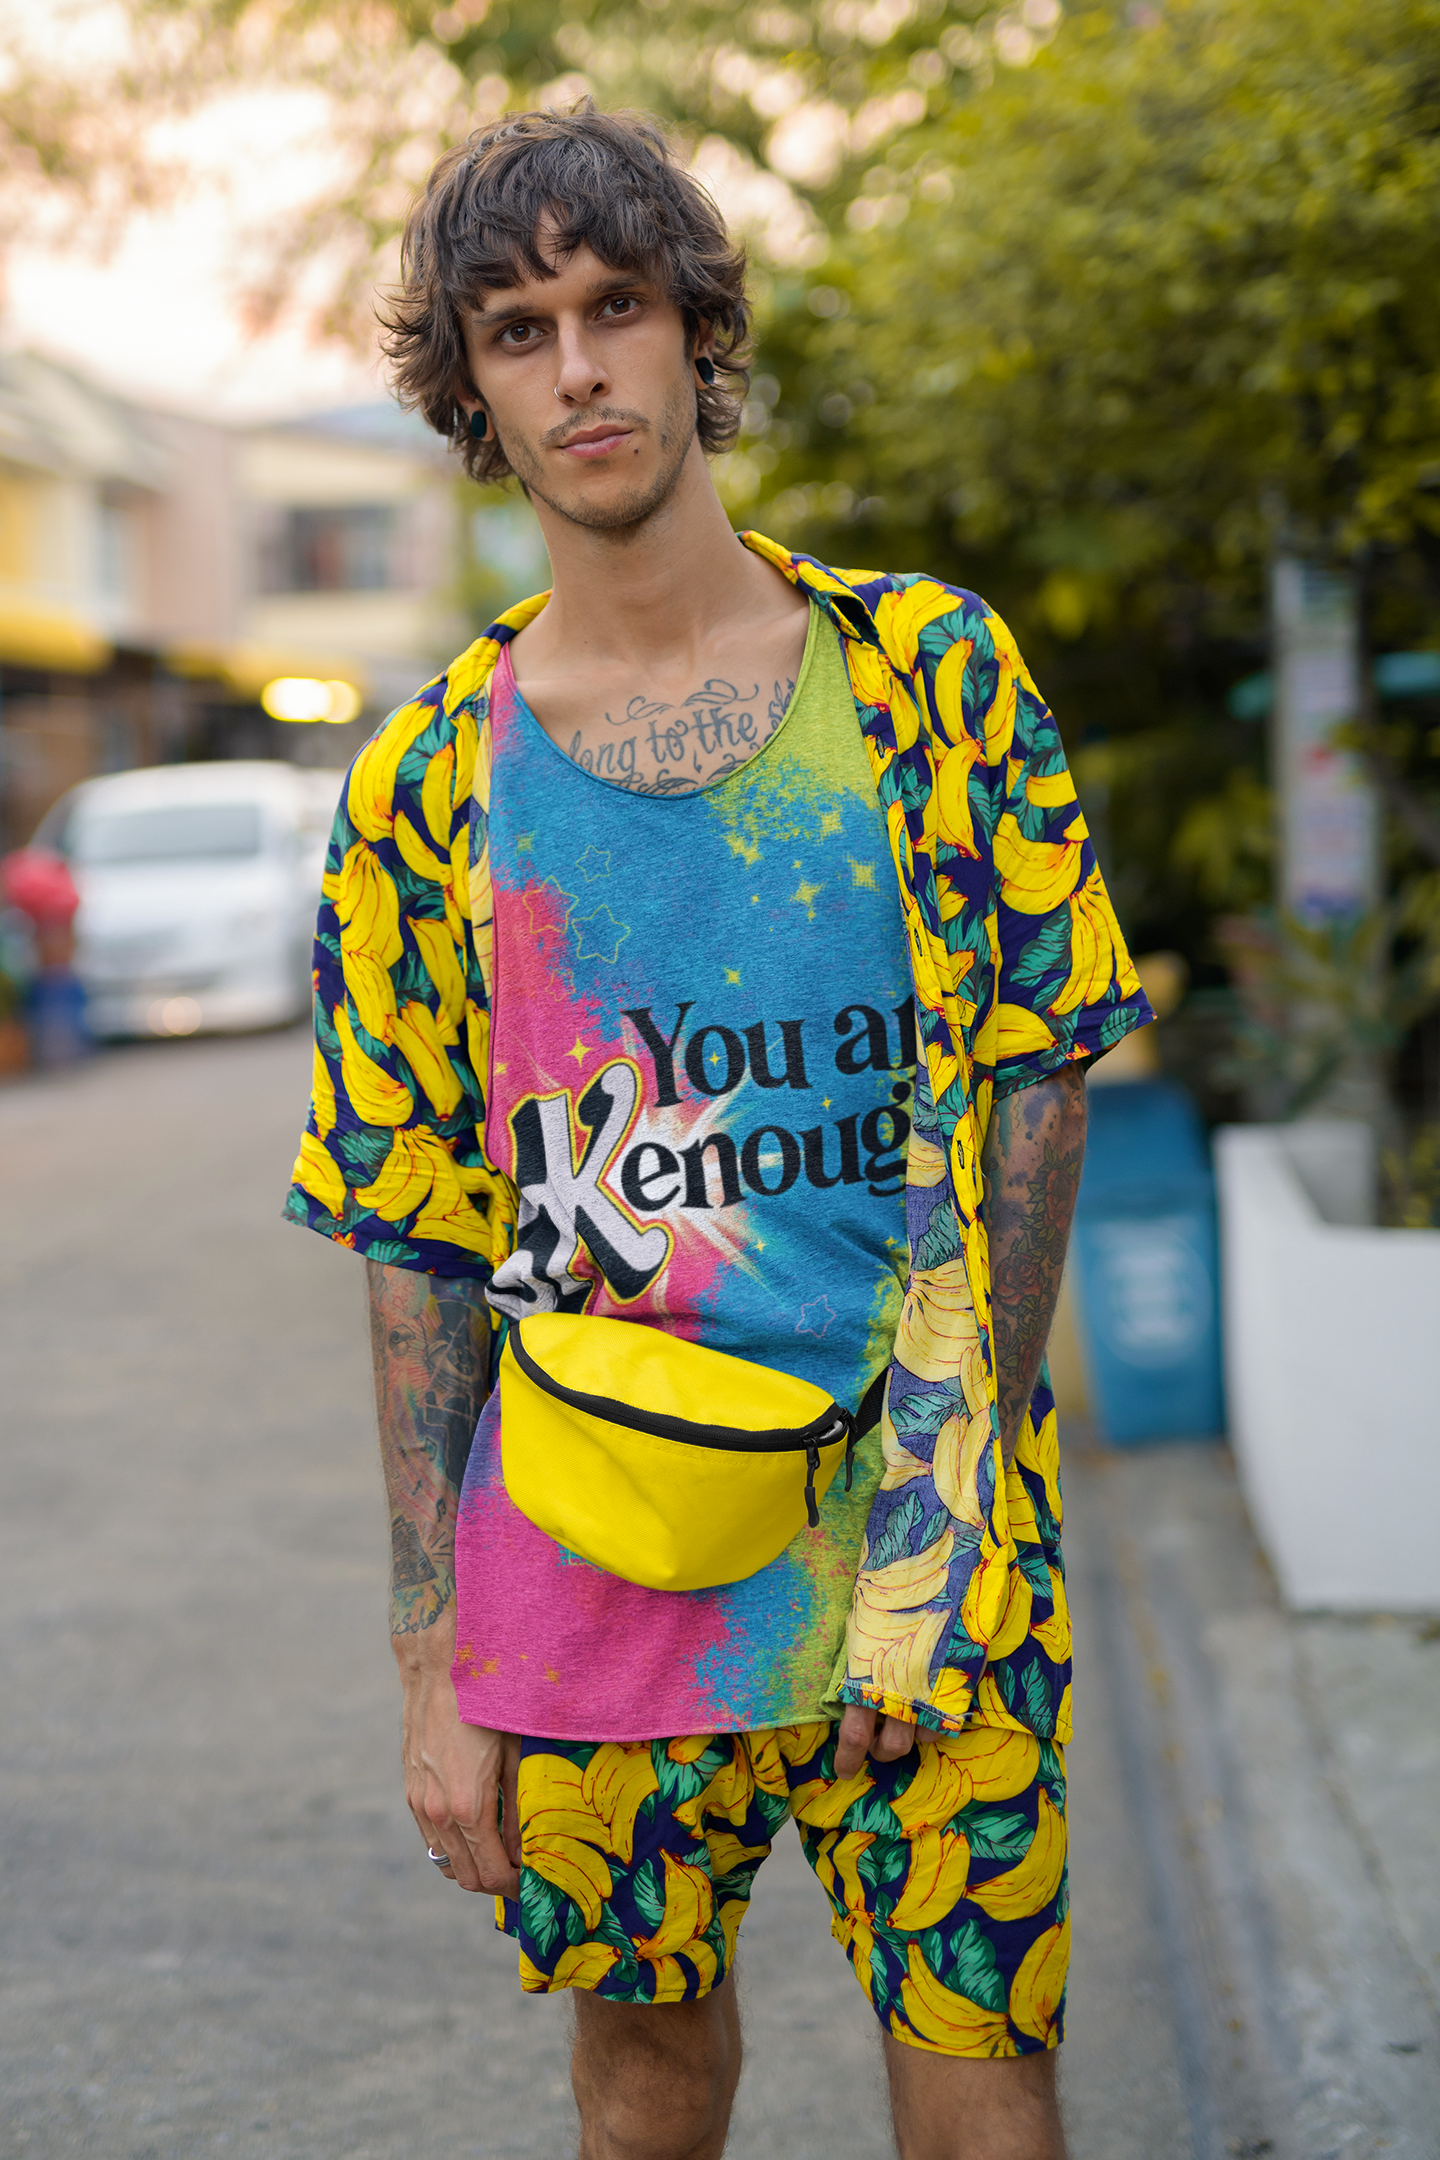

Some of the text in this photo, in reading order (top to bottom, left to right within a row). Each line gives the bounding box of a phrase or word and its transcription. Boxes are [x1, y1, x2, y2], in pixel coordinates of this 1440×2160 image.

[645, 719, 689, 763] to
[691, 706, 758, 754] the
[620, 1001, 813, 1108] You
